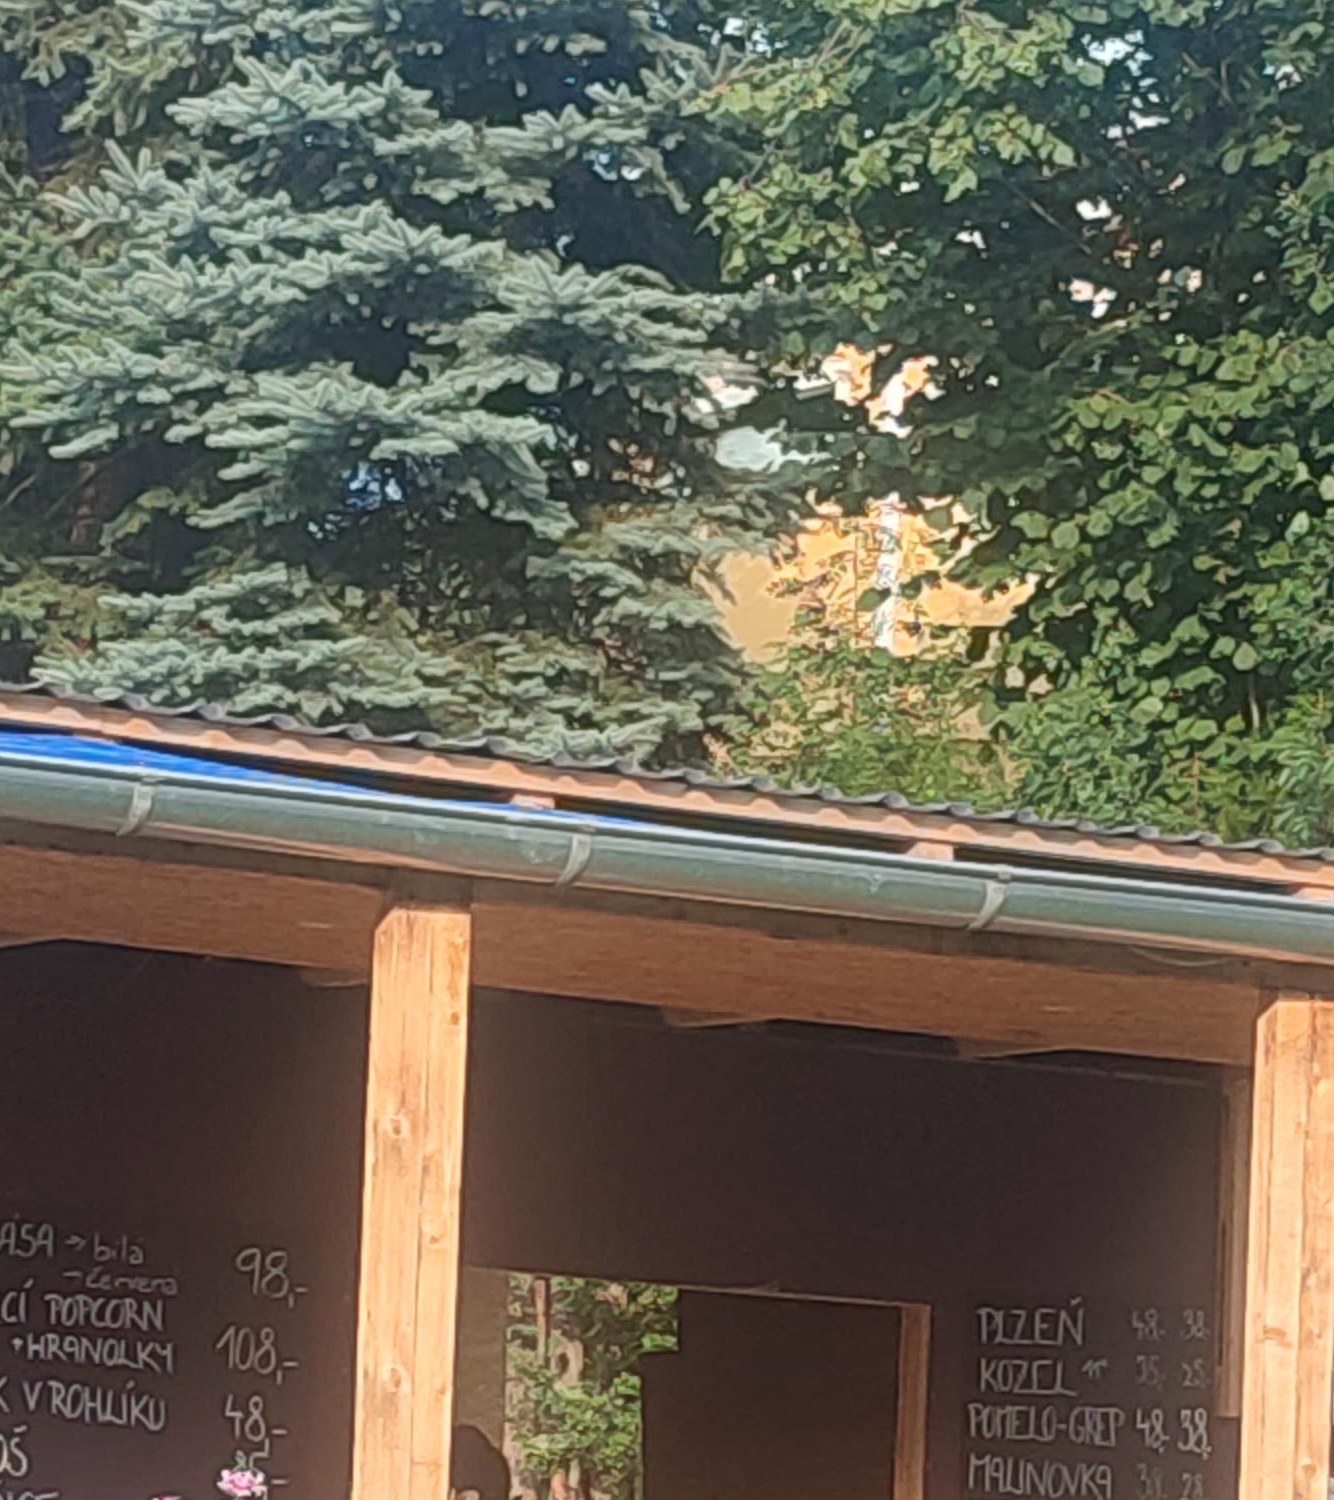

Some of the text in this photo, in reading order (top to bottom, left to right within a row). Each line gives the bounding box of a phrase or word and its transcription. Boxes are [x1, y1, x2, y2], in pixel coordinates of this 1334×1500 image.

[43, 1294, 164, 1332] POPCORN
[979, 1357, 1078, 1397] KOZEL
[22, 1380, 44, 1413] V
[47, 1379, 166, 1432] ROHLÍKU
